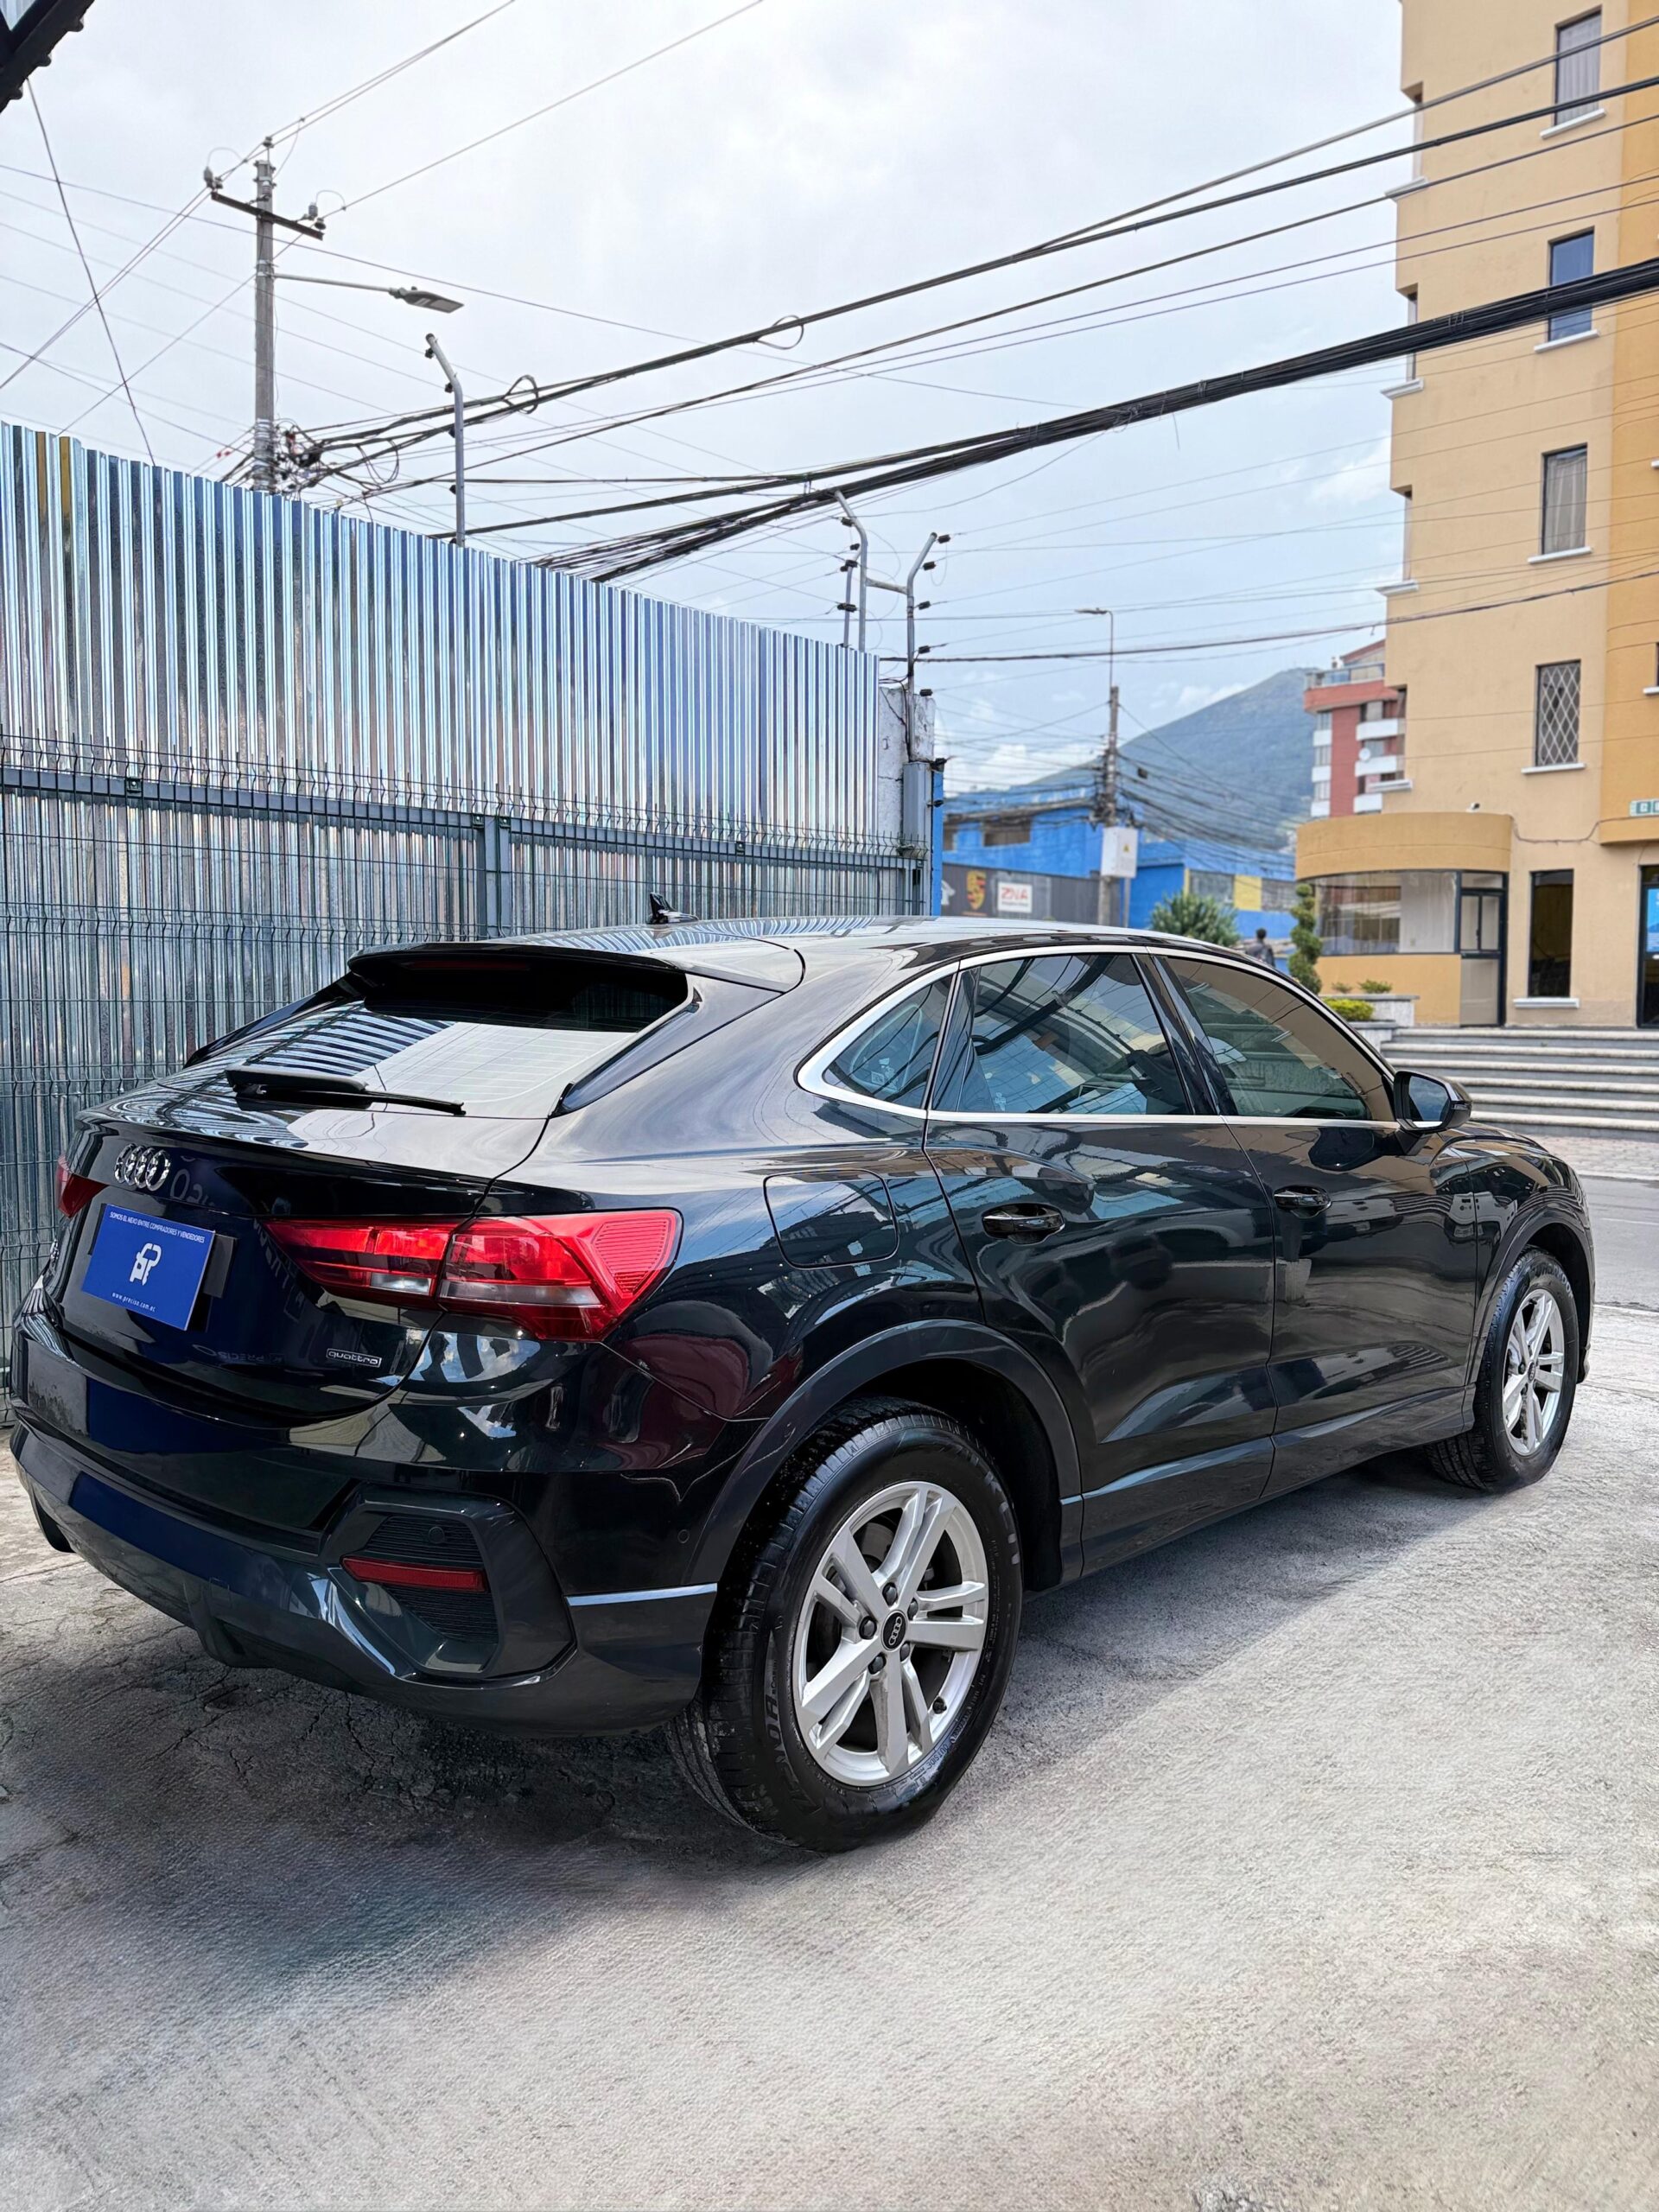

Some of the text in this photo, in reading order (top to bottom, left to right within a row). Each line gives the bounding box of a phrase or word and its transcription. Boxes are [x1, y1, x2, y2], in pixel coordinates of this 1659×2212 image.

[109, 1211, 123, 1221] SOMOS
[137, 1218, 149, 1229] ENTRE
[149, 1222, 177, 1236] COMPRADORES
[180, 1230, 206, 1243] VENDEDORES
[328, 1351, 378, 1365] quattro
[926, 1744, 949, 1770] OUTSIDE
